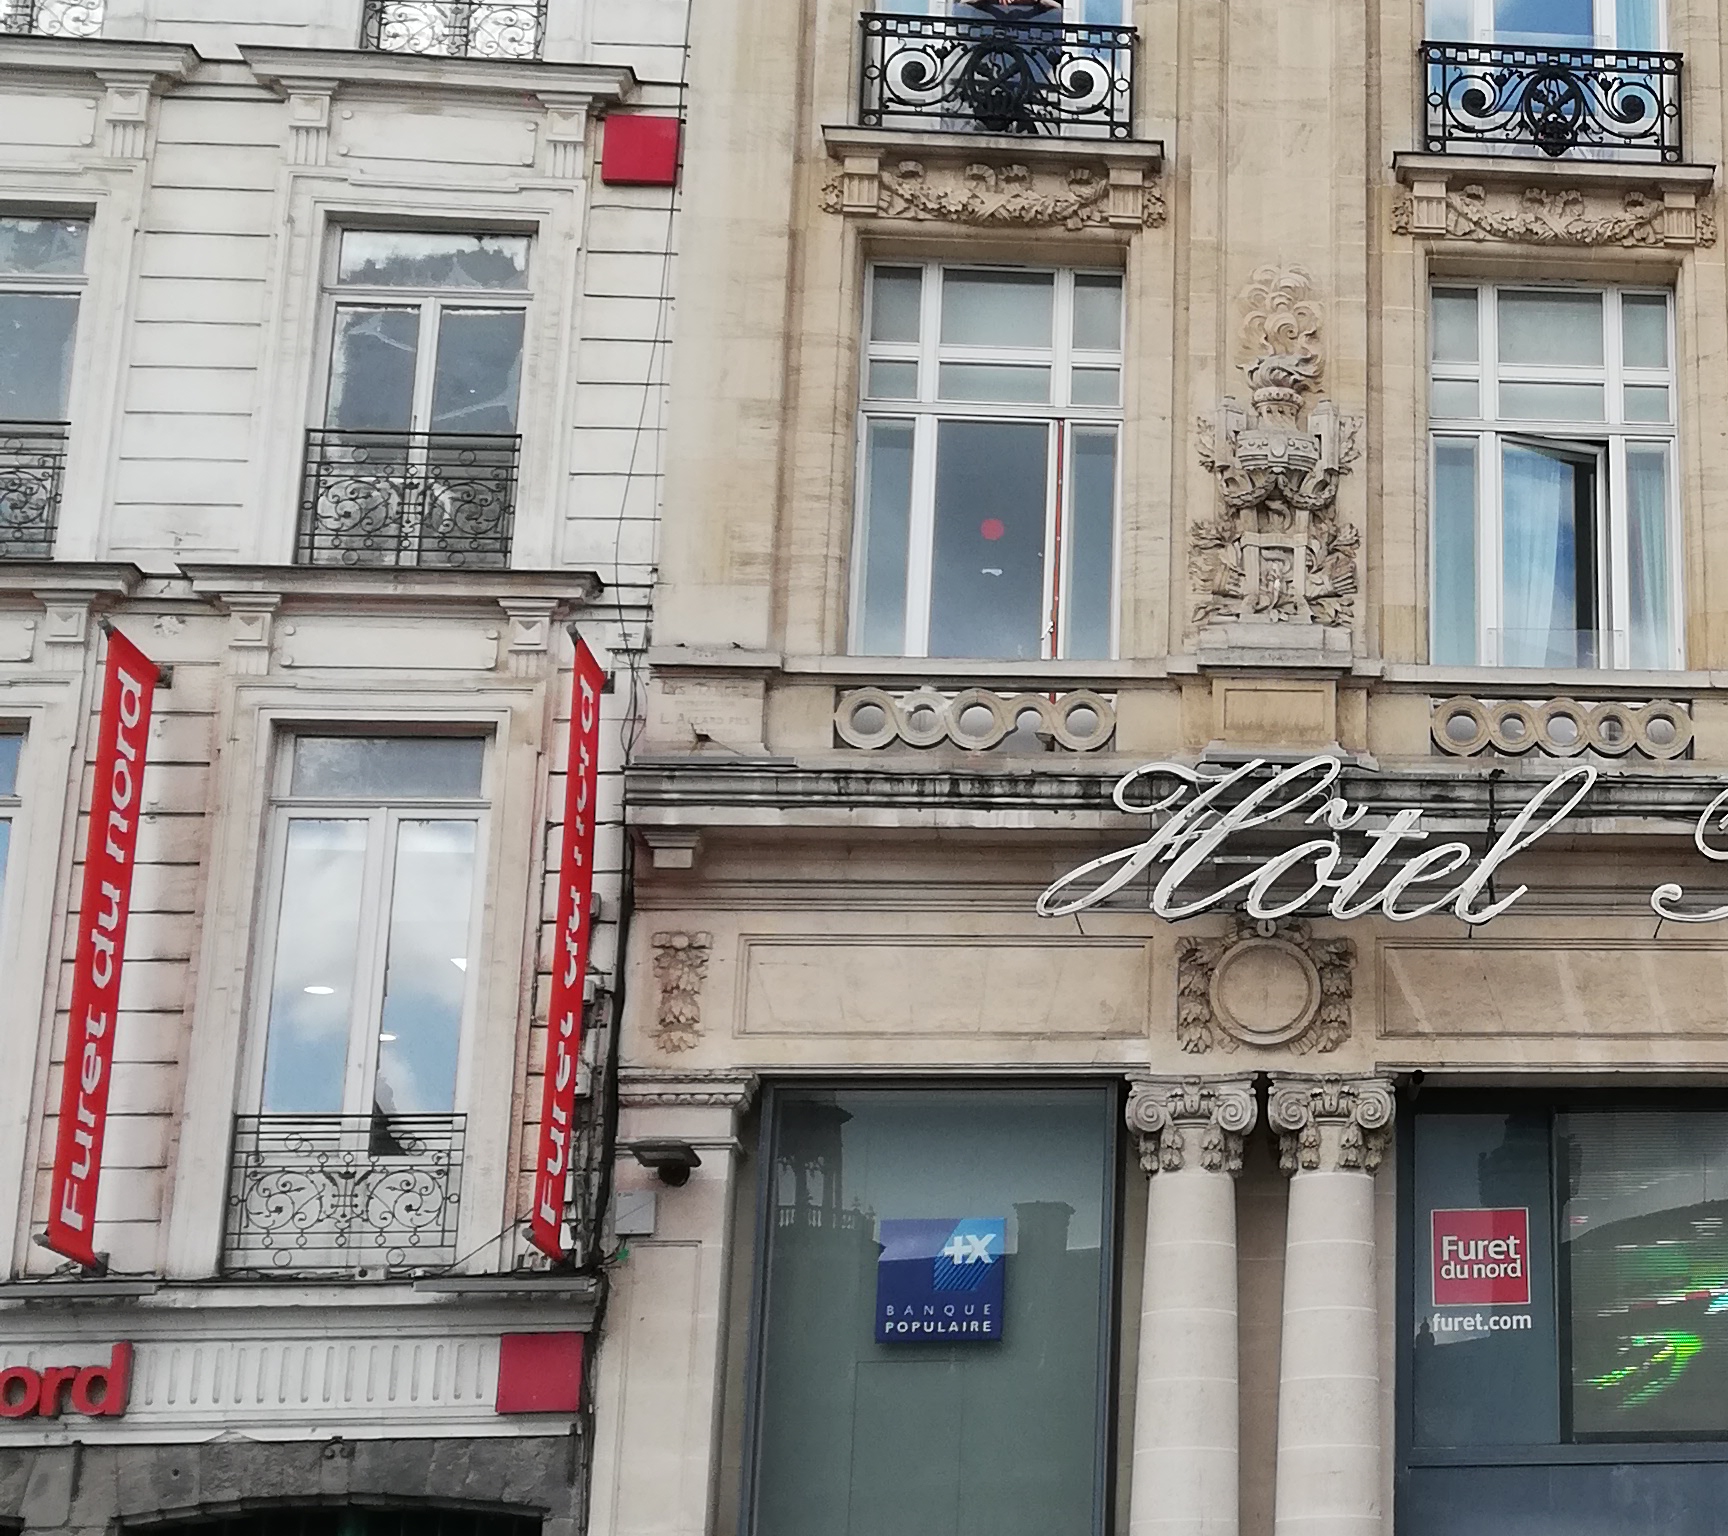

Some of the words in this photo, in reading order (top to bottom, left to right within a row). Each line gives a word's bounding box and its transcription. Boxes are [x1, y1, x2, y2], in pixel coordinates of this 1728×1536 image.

[105, 665, 143, 864] nord
[1036, 755, 1598, 924] Hôtel
[91, 879, 124, 991] du
[59, 1004, 109, 1232] Furet
[1441, 1235, 1521, 1261] Furet
[1440, 1260, 1469, 1280] du
[1473, 1259, 1522, 1279] nord
[886, 1303, 992, 1317] BANQUE
[1432, 1313, 1532, 1332] furet.com
[884, 1320, 993, 1334] POPULAIRE
